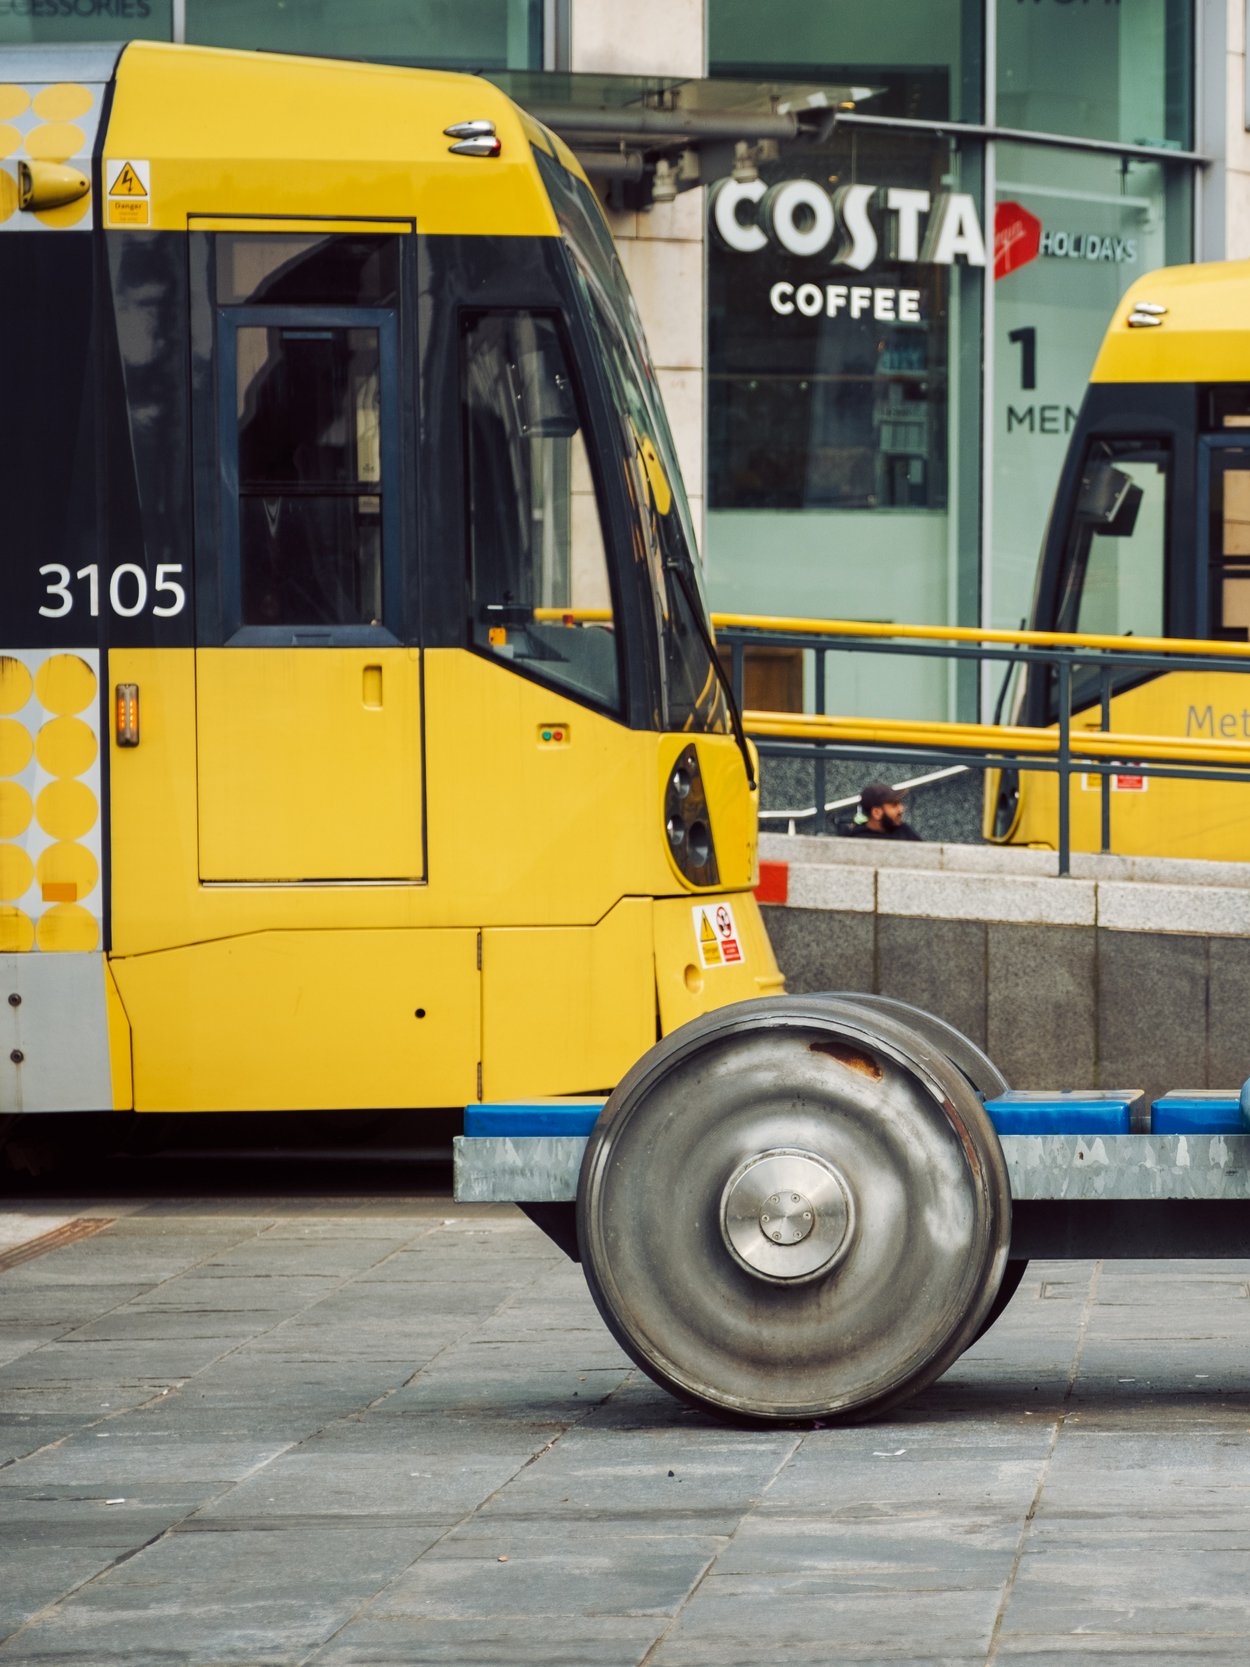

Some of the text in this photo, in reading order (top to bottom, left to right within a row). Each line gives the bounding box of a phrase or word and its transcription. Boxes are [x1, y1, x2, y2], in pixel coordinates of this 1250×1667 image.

[712, 177, 987, 272] COSTA
[1038, 231, 1138, 264] HOLIDAYS
[769, 281, 922, 323] COFFEE
[1007, 325, 1037, 391] 1
[38, 562, 186, 618] 3105
